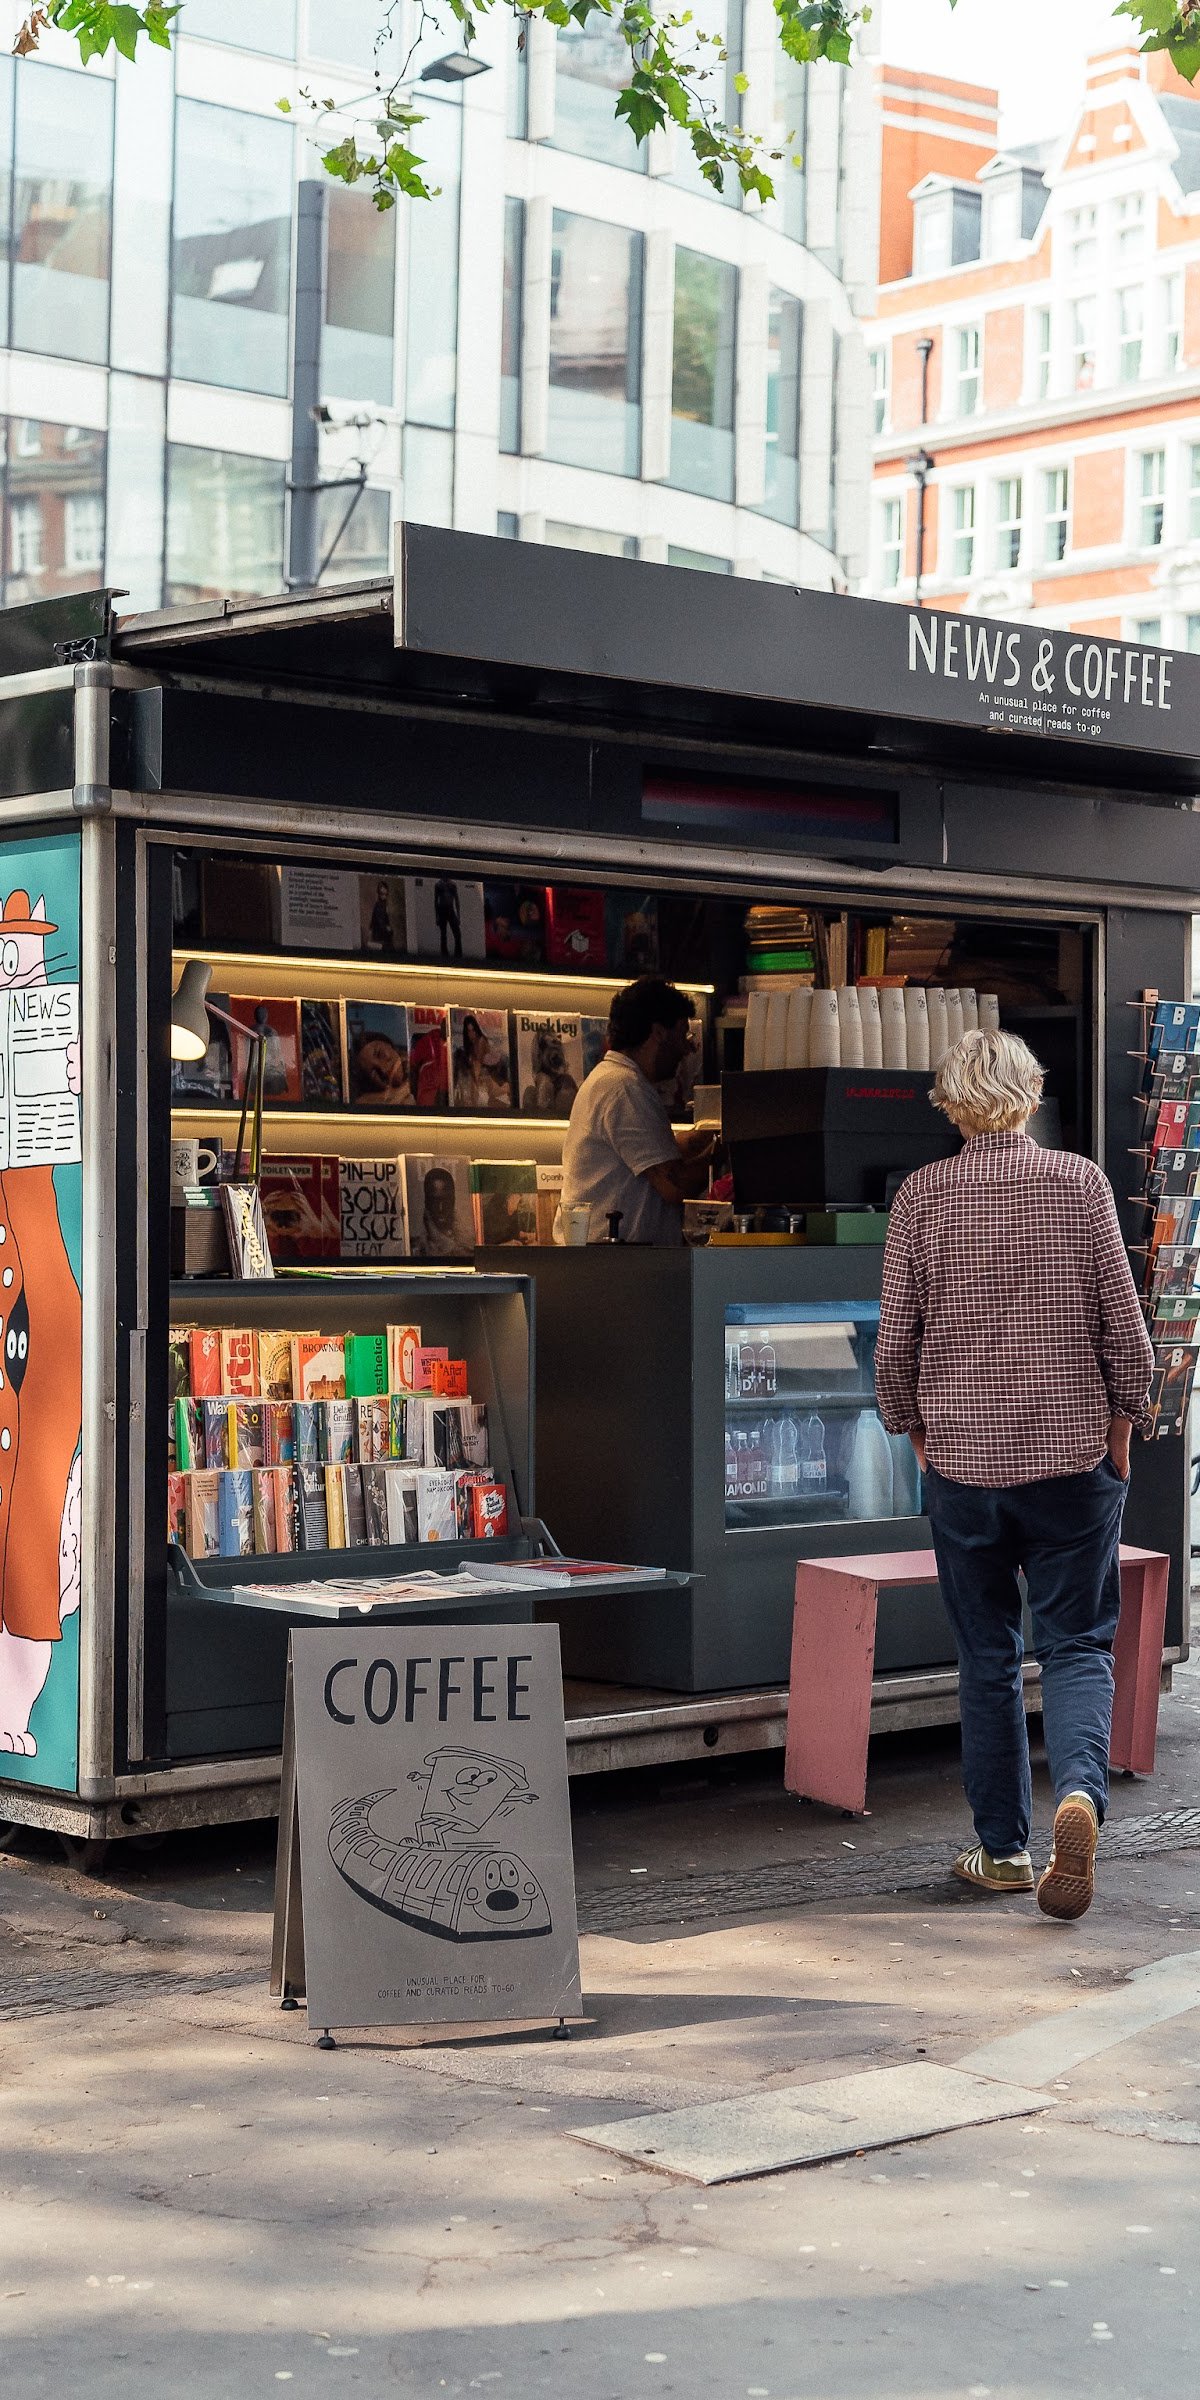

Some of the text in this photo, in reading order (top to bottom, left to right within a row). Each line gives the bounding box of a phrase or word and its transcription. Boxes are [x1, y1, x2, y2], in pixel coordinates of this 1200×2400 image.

[908, 613, 1174, 710] NEWS & COFFEE
[979, 692, 1111, 719] An unusual place for coffee
[989, 709, 1101, 735] and curated reads to-go
[13, 992, 71, 1022] NEWS
[520, 1016, 578, 1038] Buckley
[339, 1162, 397, 1182] PIN-UP
[341, 1185, 399, 1214] BODY
[341, 1214, 403, 1241] ISSUE
[324, 1655, 532, 1725] COFFEE
[377, 1989, 401, 1999] COFFEE
[405, 1988, 422, 1998] AND
[426, 1986, 459, 1996] CURATED
[463, 1985, 488, 1995] READS
[406, 1974, 485, 1986] UNUSUAL PLACE FOR
